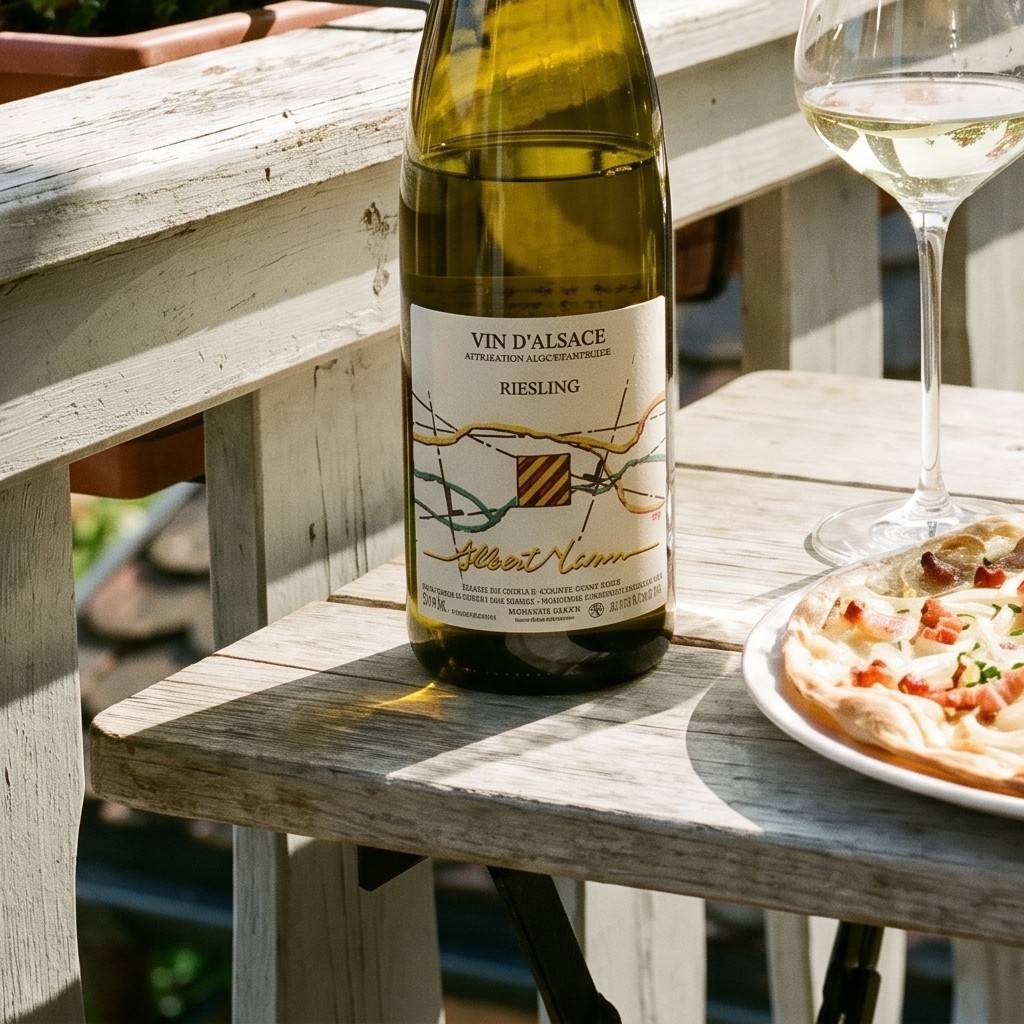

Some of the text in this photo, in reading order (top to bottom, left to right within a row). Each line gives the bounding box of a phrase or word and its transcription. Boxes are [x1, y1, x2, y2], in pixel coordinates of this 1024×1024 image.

[471, 328, 606, 350] VIN D'ALSACE
[500, 379, 580, 395] RIESLING
